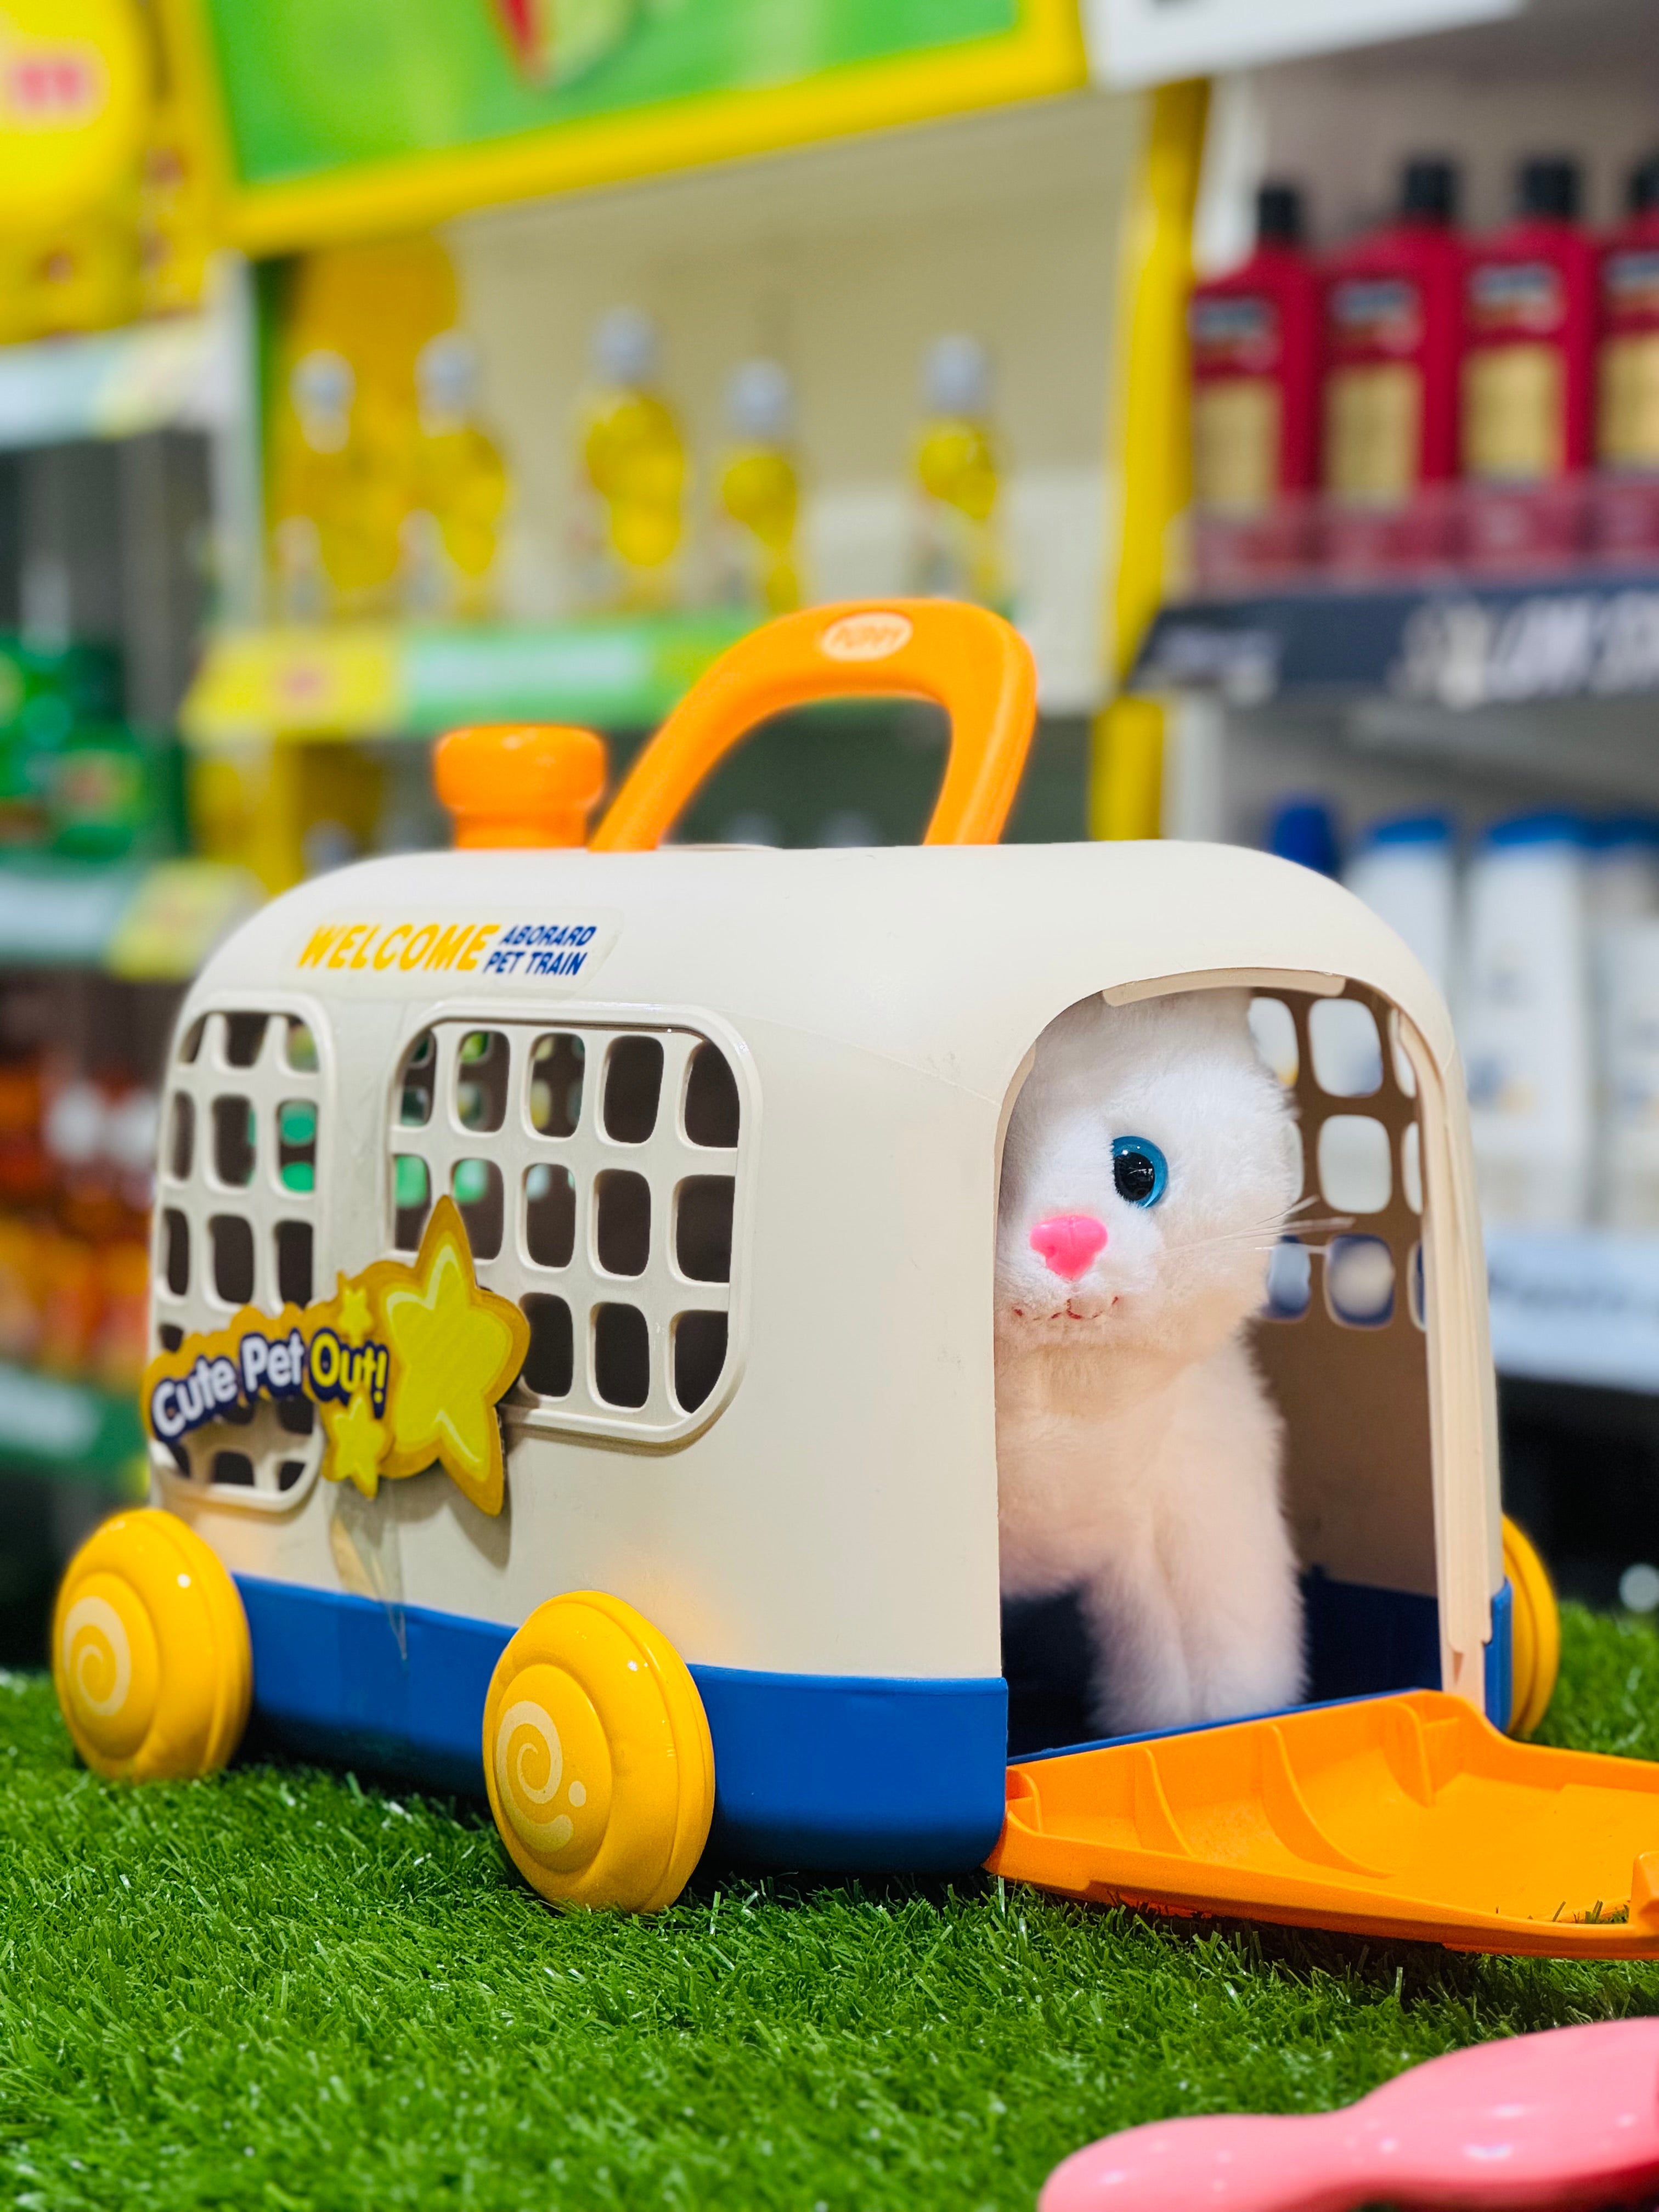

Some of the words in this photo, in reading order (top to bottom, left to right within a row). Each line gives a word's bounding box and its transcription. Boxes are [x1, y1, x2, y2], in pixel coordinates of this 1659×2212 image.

[297, 923, 500, 971] WELCOME
[501, 926, 597, 946] ABORARD
[483, 951, 525, 974] PET
[525, 952, 588, 975] TRAIN
[151, 1357, 238, 1438] Cute
[240, 1330, 306, 1393] Pet
[309, 1331, 390, 1404] Out!
